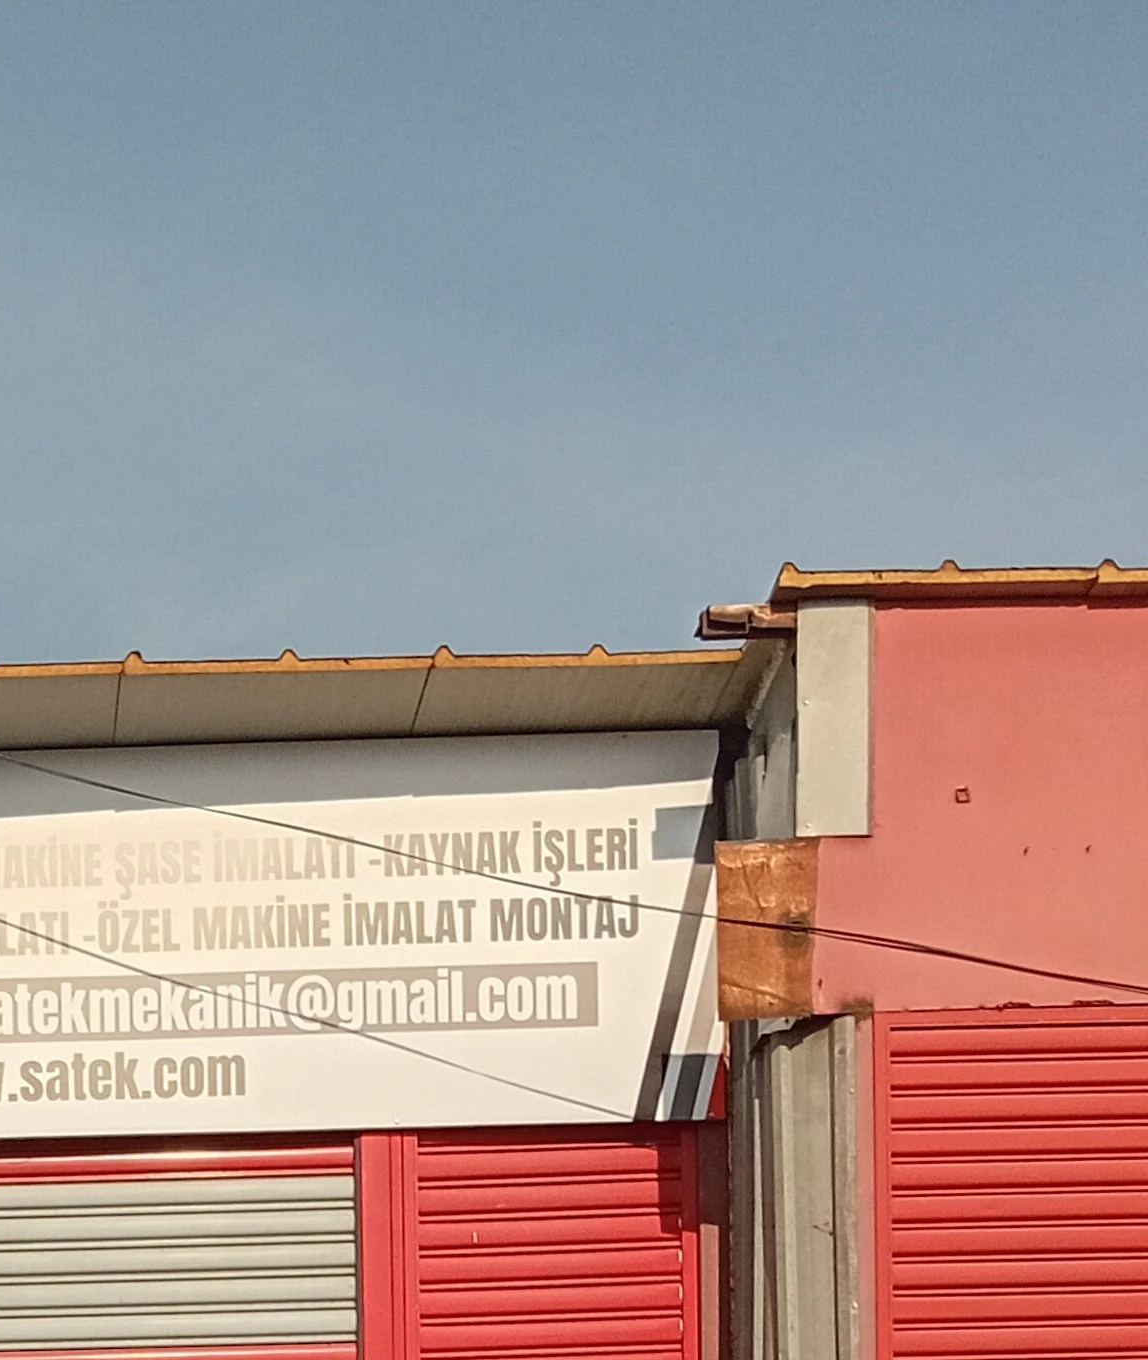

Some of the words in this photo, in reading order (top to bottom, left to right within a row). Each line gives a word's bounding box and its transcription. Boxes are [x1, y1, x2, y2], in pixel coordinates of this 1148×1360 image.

[115, 840, 201, 900] ŞASE
[213, 830, 356, 883] İMALATI
[369, 830, 521, 877] -KAYNAK
[533, 818, 639, 885] İŞLERİ
[82, 901, 180, 954] -ÖZEL
[192, 895, 331, 951] MAKİNE
[343, 893, 476, 946] İMALAT
[489, 895, 639, 943] MONTAJ
